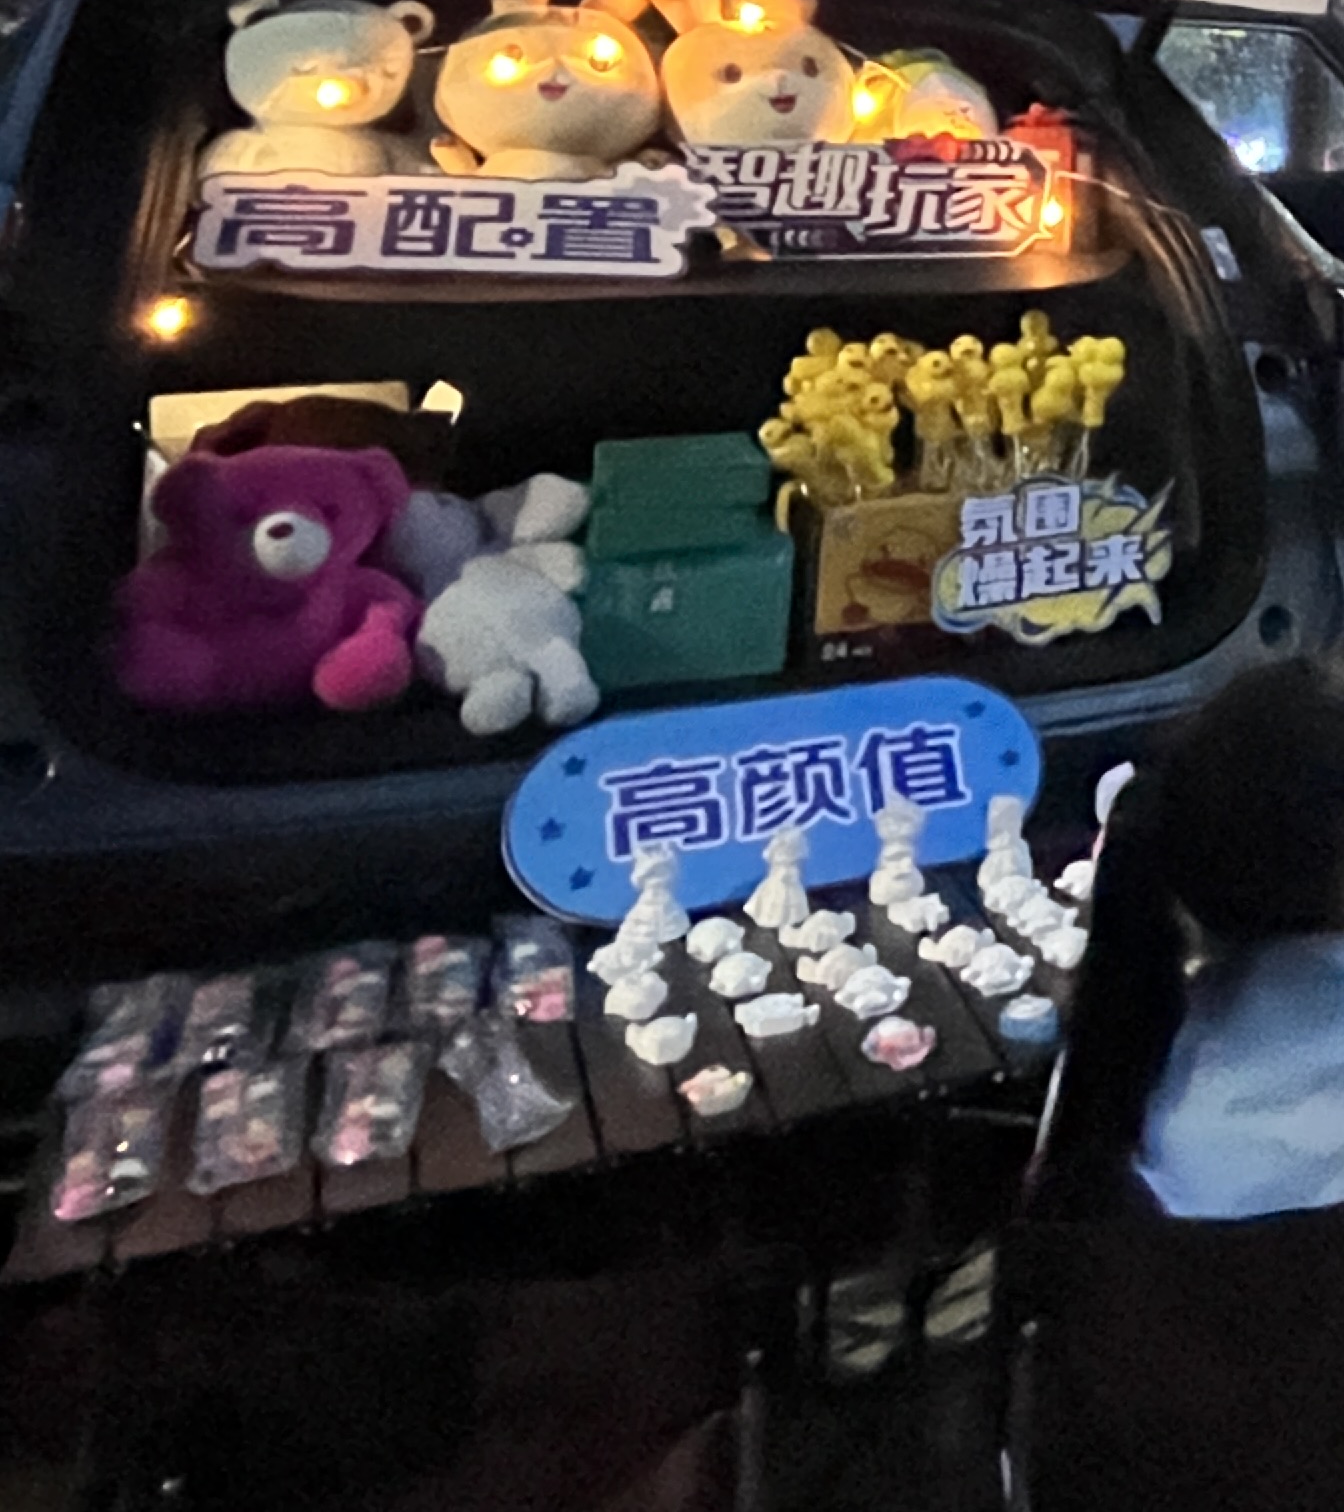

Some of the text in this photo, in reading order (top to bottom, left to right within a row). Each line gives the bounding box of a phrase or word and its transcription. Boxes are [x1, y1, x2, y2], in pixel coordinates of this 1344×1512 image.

[215, 184, 664, 265] 高配置
[680, 139, 1034, 238] 智趣玩家
[959, 484, 1081, 549] 氛围
[602, 722, 970, 861] 高颜值
